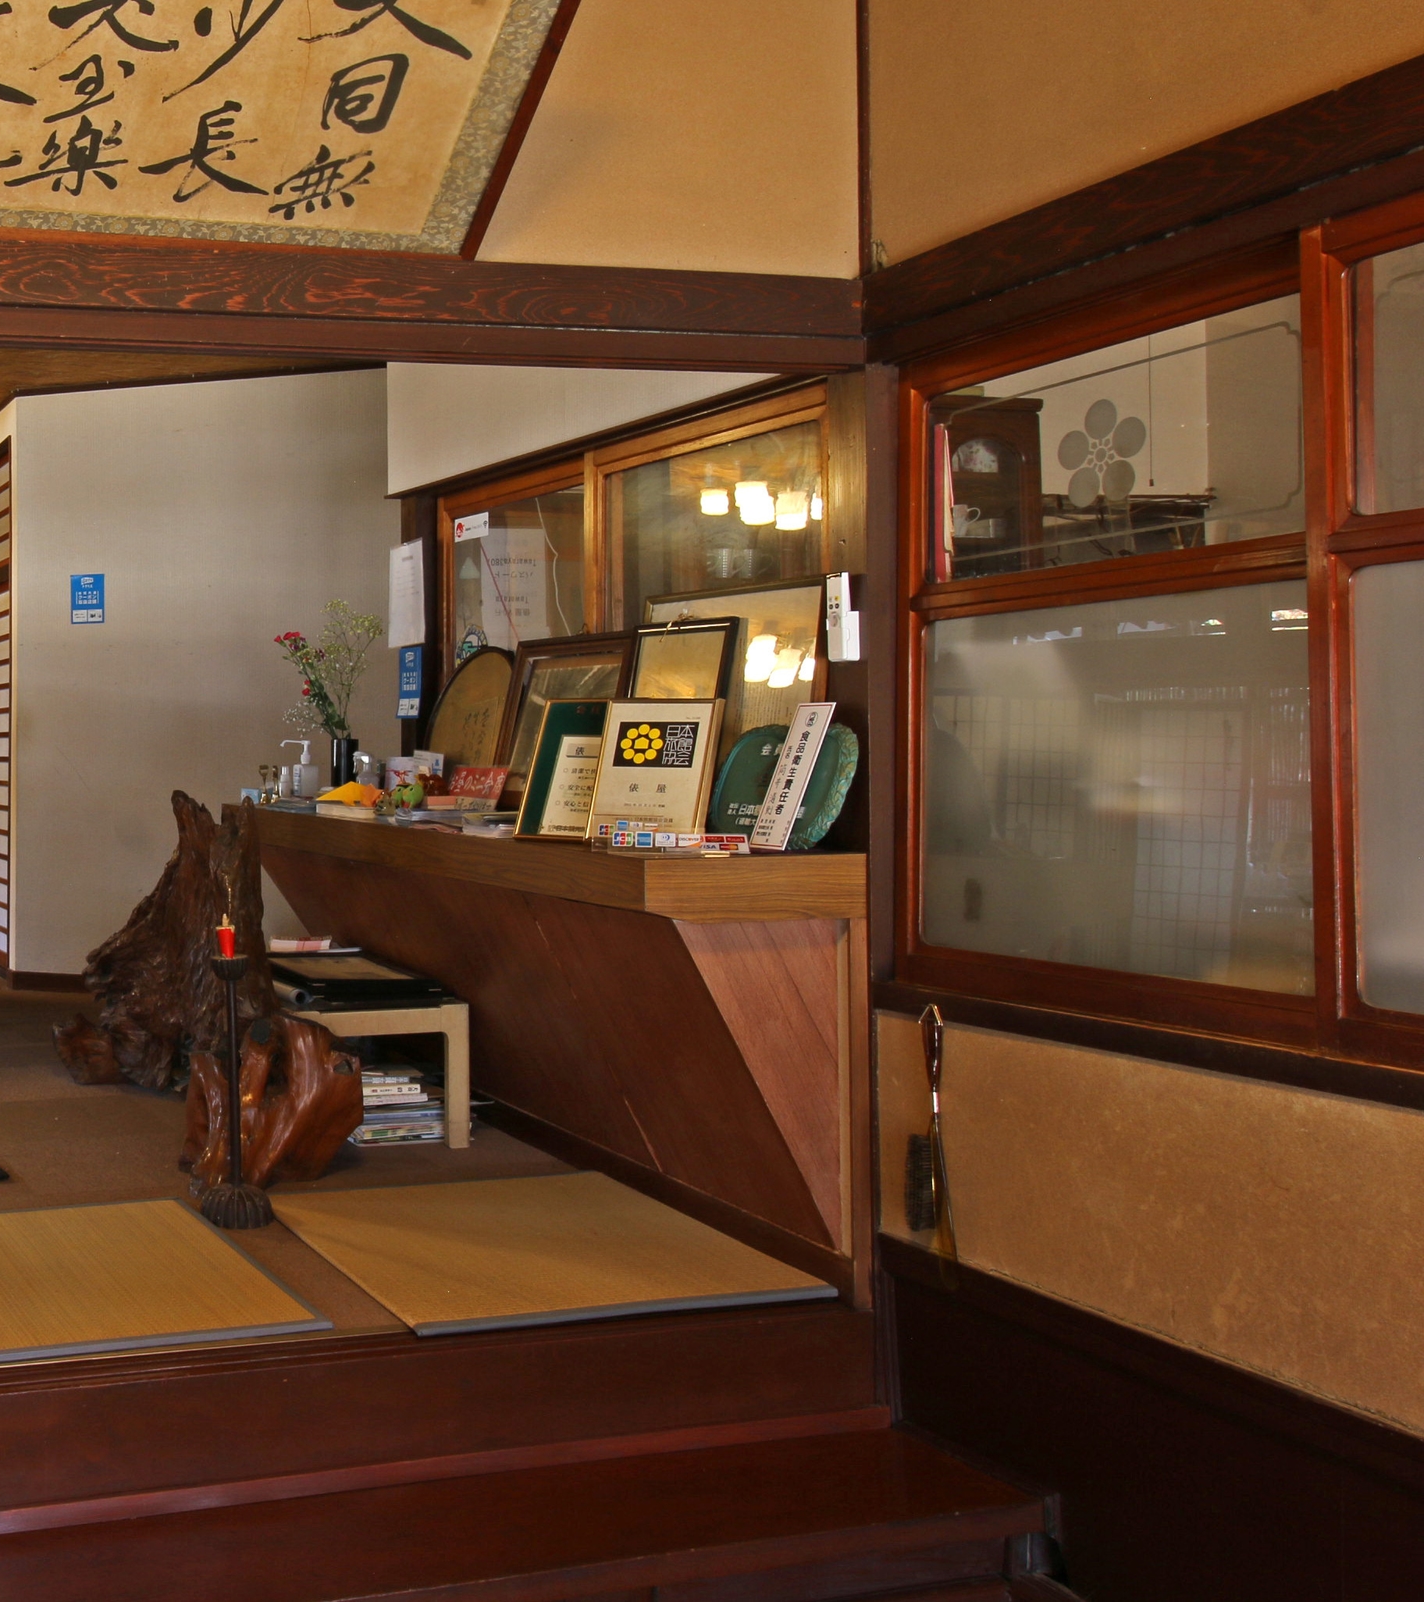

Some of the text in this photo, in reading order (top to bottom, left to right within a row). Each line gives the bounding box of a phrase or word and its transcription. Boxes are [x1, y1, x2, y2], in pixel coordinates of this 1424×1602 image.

[666, 725, 695, 738] 日本
[774, 730, 811, 815] 食品衛生責任者
